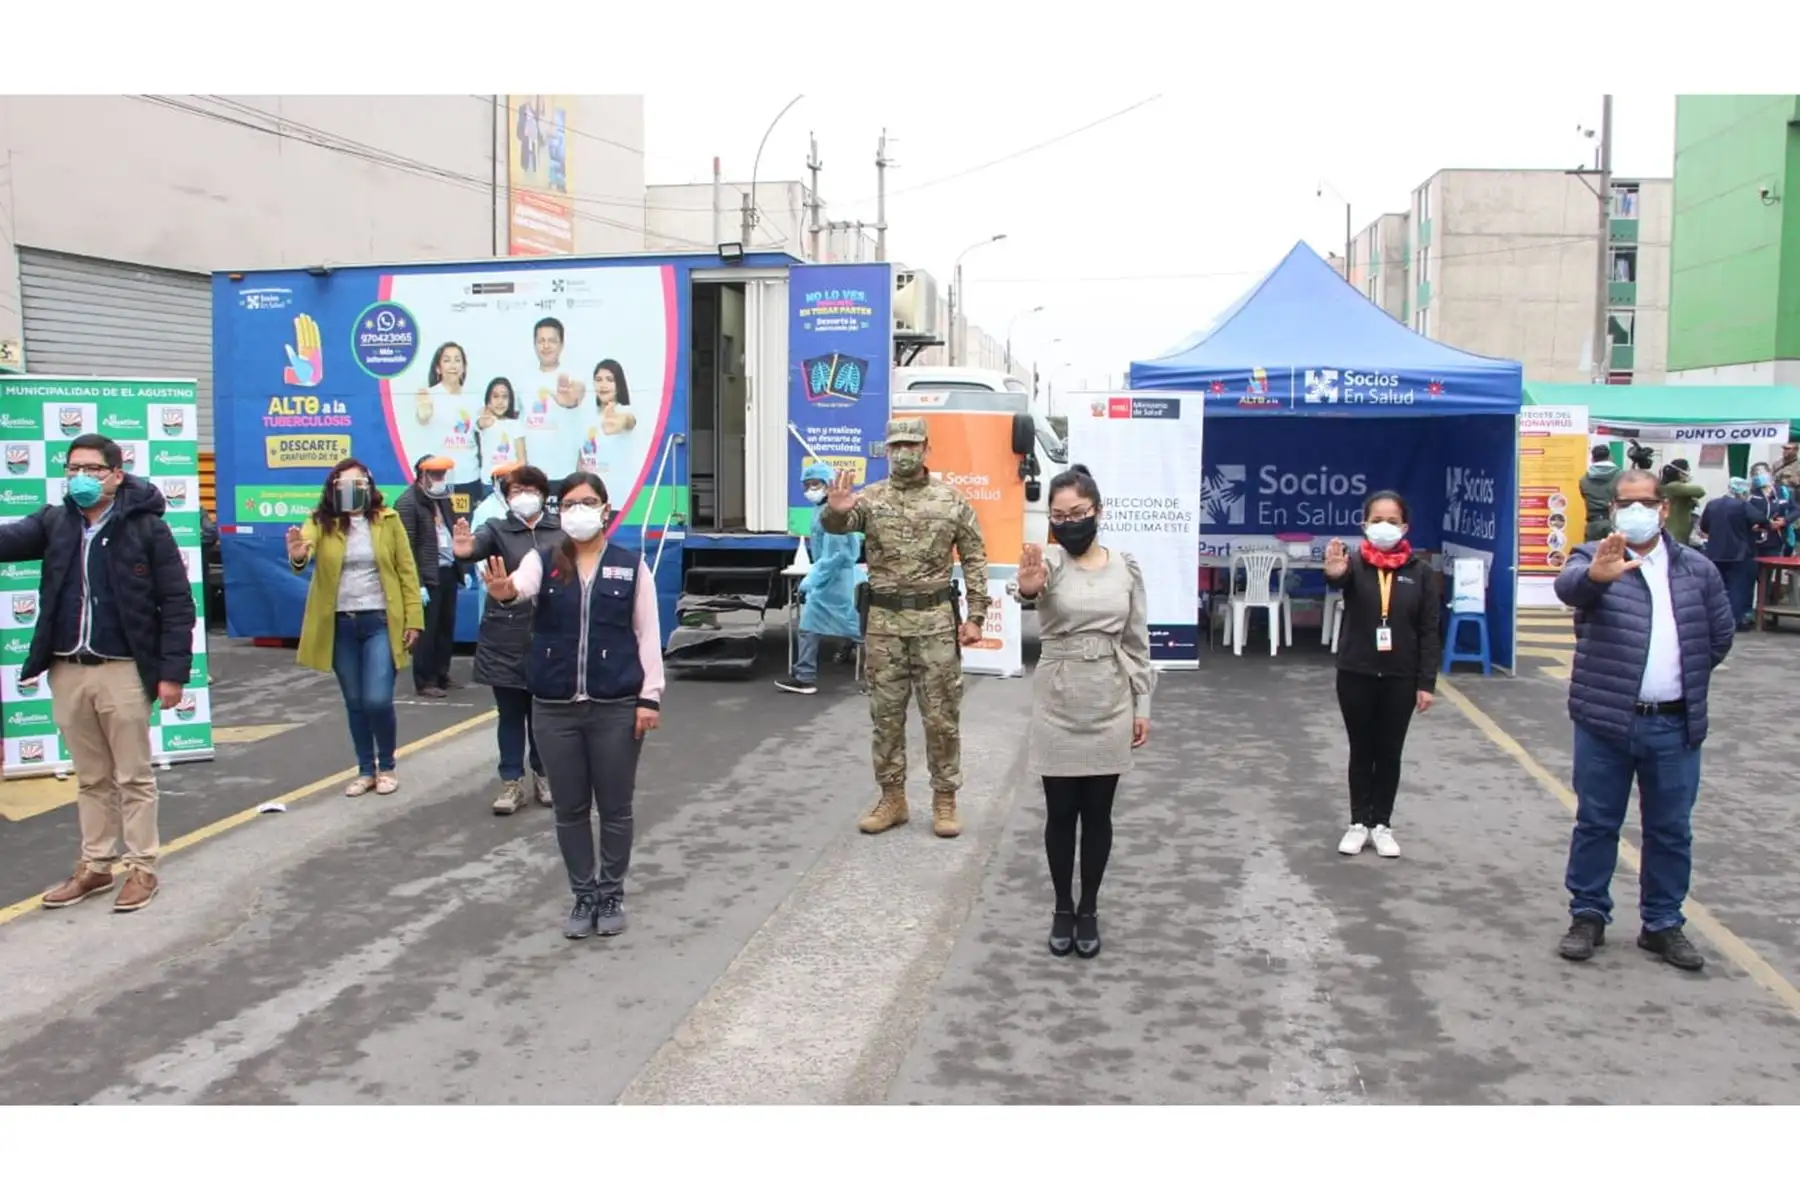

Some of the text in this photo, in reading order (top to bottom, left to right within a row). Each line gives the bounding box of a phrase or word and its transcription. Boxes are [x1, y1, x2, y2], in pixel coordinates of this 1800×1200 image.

[805, 290, 821, 303] NO
[824, 289, 840, 300] LO
[1343, 369, 1399, 386] Socios
[5, 386, 194, 398] MUNICIPALIDAD DE EL AGUSTINO
[1343, 387, 1415, 405] En Salud
[321, 403, 331, 414] a
[333, 400, 347, 414] la
[262, 414, 352, 428] TUBERCULOSIS
[1675, 427, 1778, 440] PUNTO COVID
[279, 440, 339, 452] DESCARTE
[945, 472, 990, 486] Socios
[1257, 464, 1369, 497] Socios
[1463, 466, 1495, 505] Socios
[964, 486, 1001, 500] Salud
[1164, 498, 1180, 509] DE
[1114, 511, 1192, 522] INTEGRADAS
[1257, 499, 1288, 526] En
[1134, 523, 1162, 533] LIMA
[1163, 524, 1190, 533] ESTE
[1460, 507, 1496, 541] En Salud
